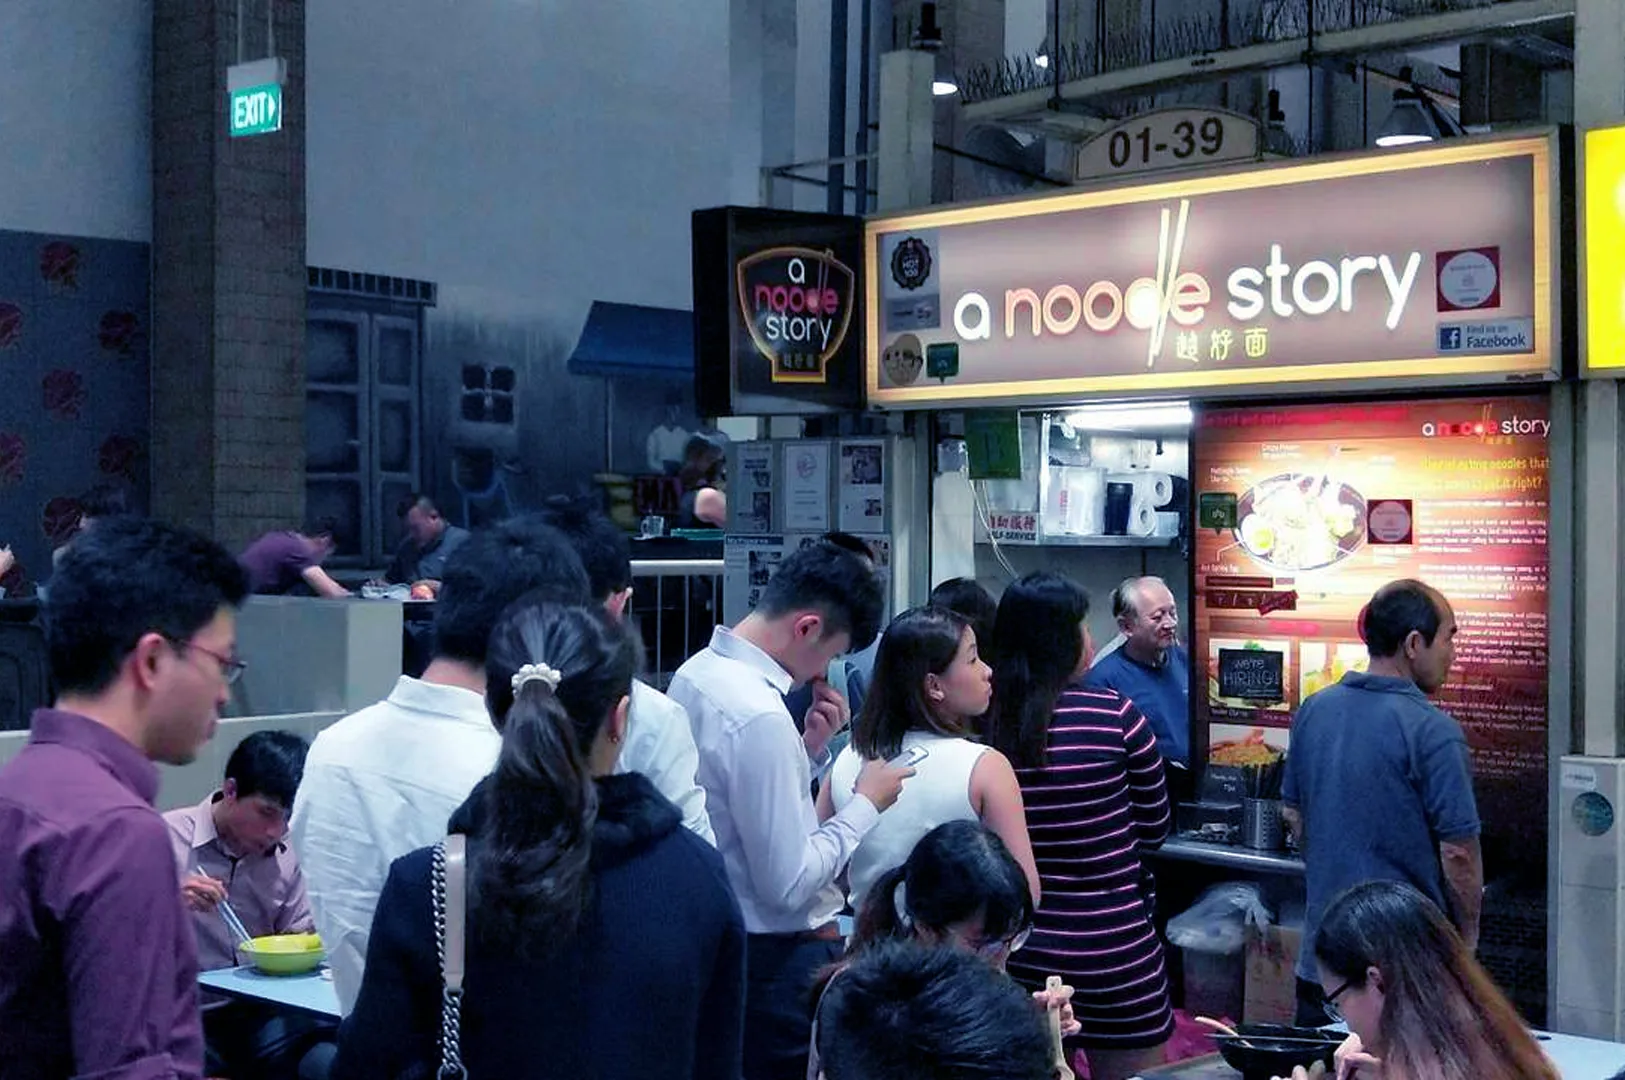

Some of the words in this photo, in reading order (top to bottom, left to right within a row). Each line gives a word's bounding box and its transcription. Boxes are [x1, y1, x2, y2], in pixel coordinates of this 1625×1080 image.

[234, 91, 267, 129] EXIT
[1109, 117, 1224, 168] 01-39
[788, 258, 805, 284] a
[953, 292, 991, 341] a
[1227, 243, 1422, 330] story
[765, 313, 833, 351] story
[1466, 333, 1526, 349] Facebook
[1421, 422, 1435, 437] a
[1501, 415, 1551, 437] story
[1223, 670, 1280, 686] HIRING!
